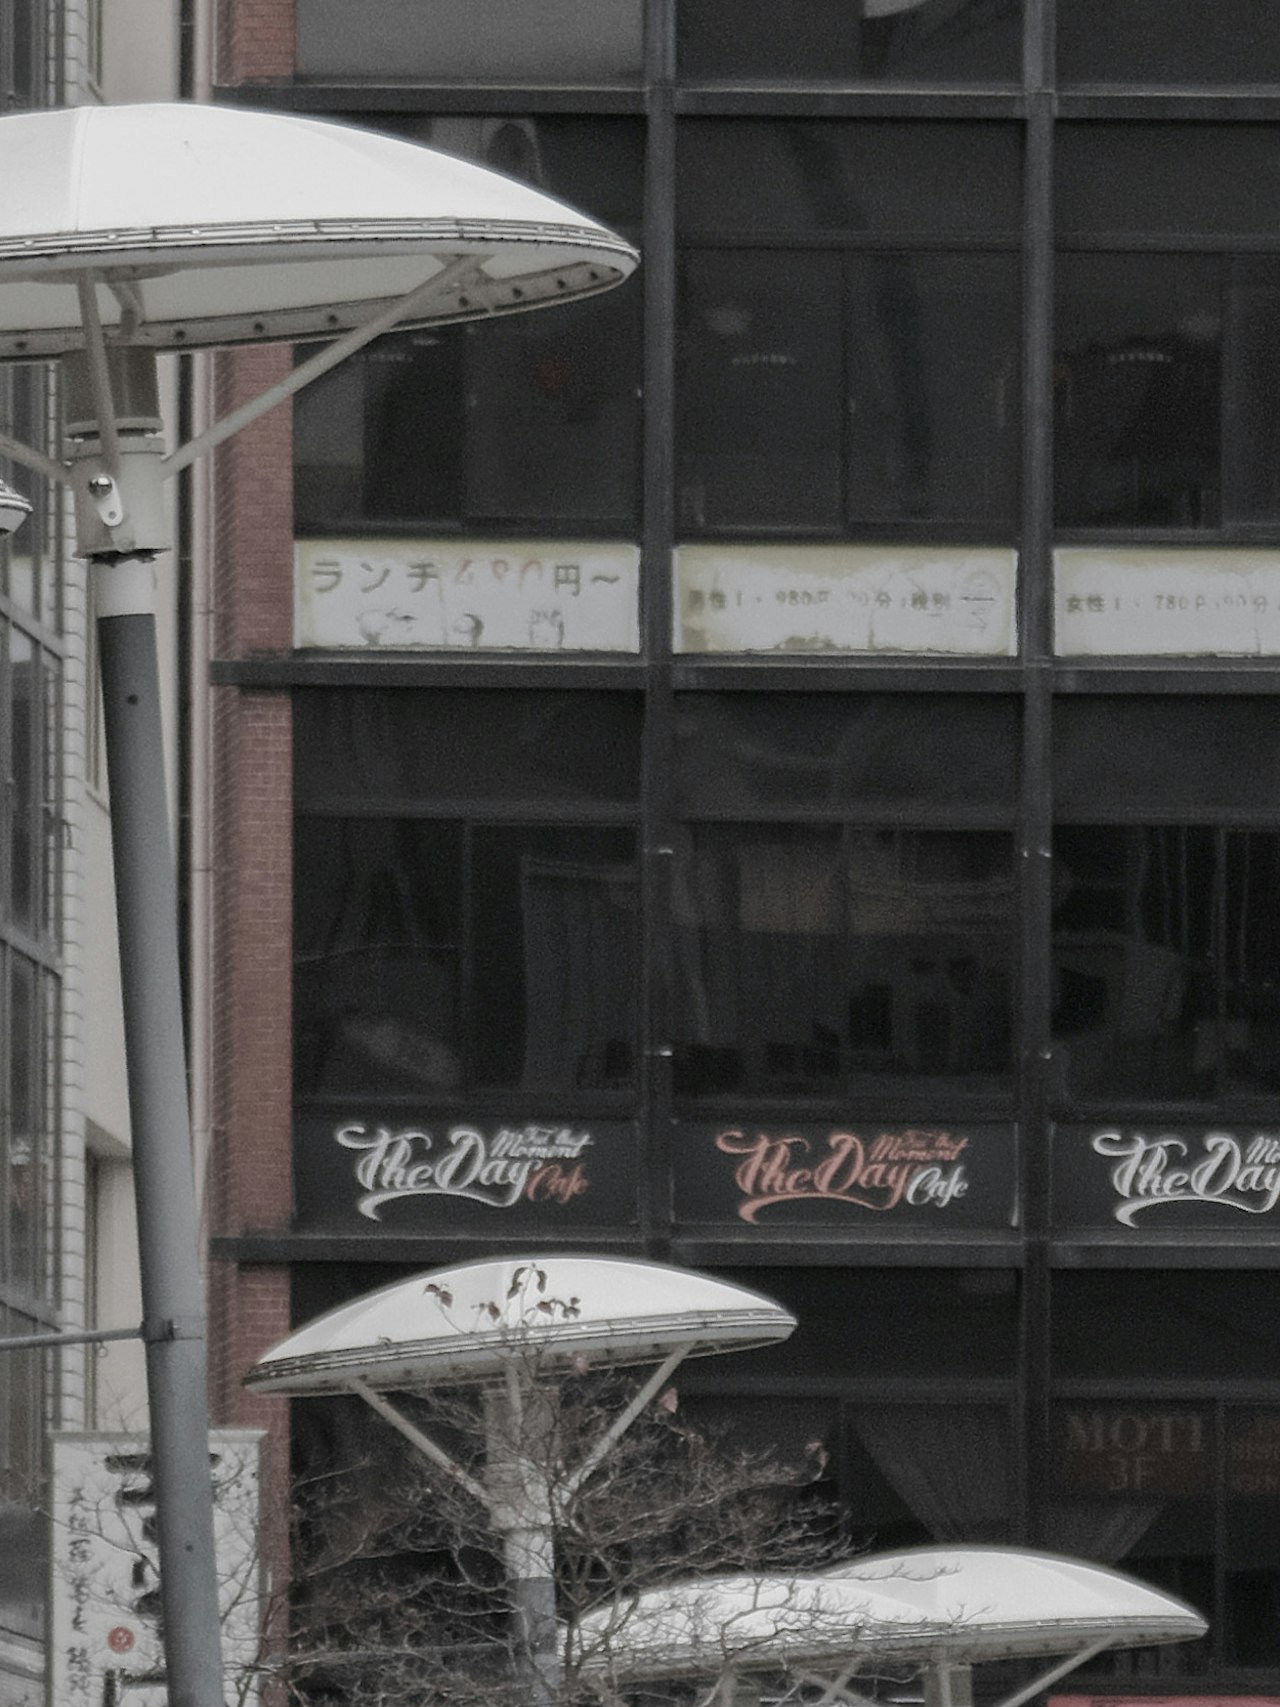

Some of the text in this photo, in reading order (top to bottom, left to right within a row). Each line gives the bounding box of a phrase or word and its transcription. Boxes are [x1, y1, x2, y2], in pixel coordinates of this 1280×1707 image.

[337, 1126, 433, 1191] The
[527, 1164, 589, 1204] Cafe
[716, 1130, 811, 1194] The
[907, 1166, 969, 1207] Cafe
[1093, 1134, 1188, 1198] The
